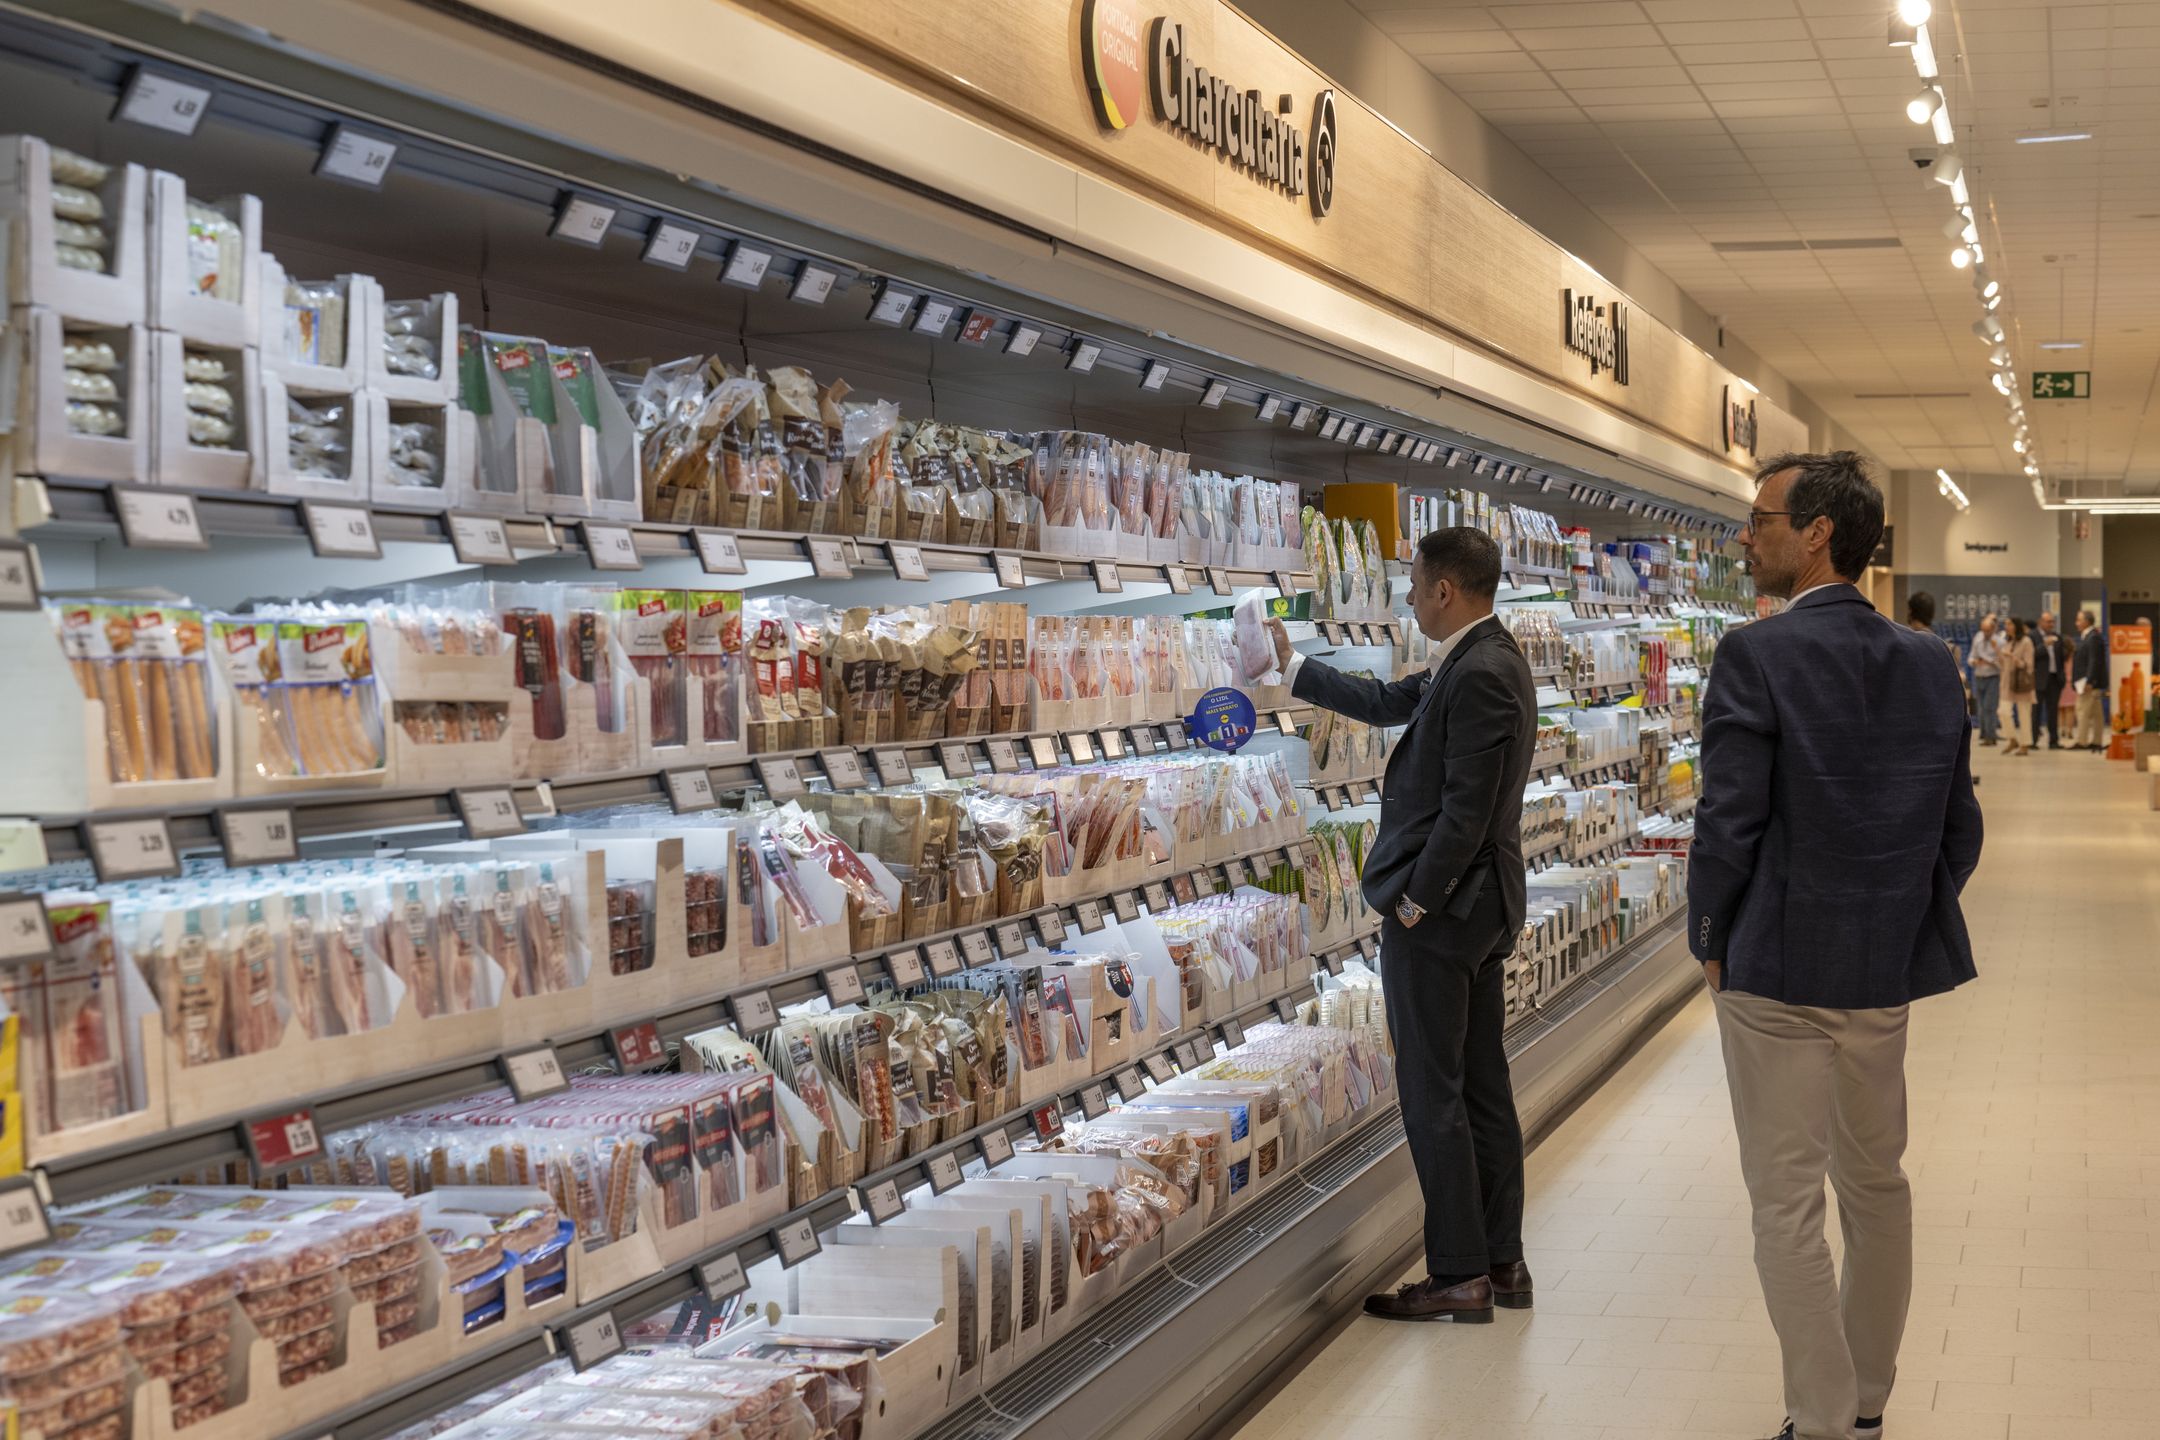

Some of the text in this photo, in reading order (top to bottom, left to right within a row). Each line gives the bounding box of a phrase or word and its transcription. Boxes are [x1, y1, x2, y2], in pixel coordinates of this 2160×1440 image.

[1102, 2, 1138, 42] PORTUGAL
[1102, 30, 1138, 72] ORIGINAL
[1150, 16, 1304, 195] Charcutaria
[1219, 703, 1239, 712] BARATO
[1224, 727, 1231, 737] 1
